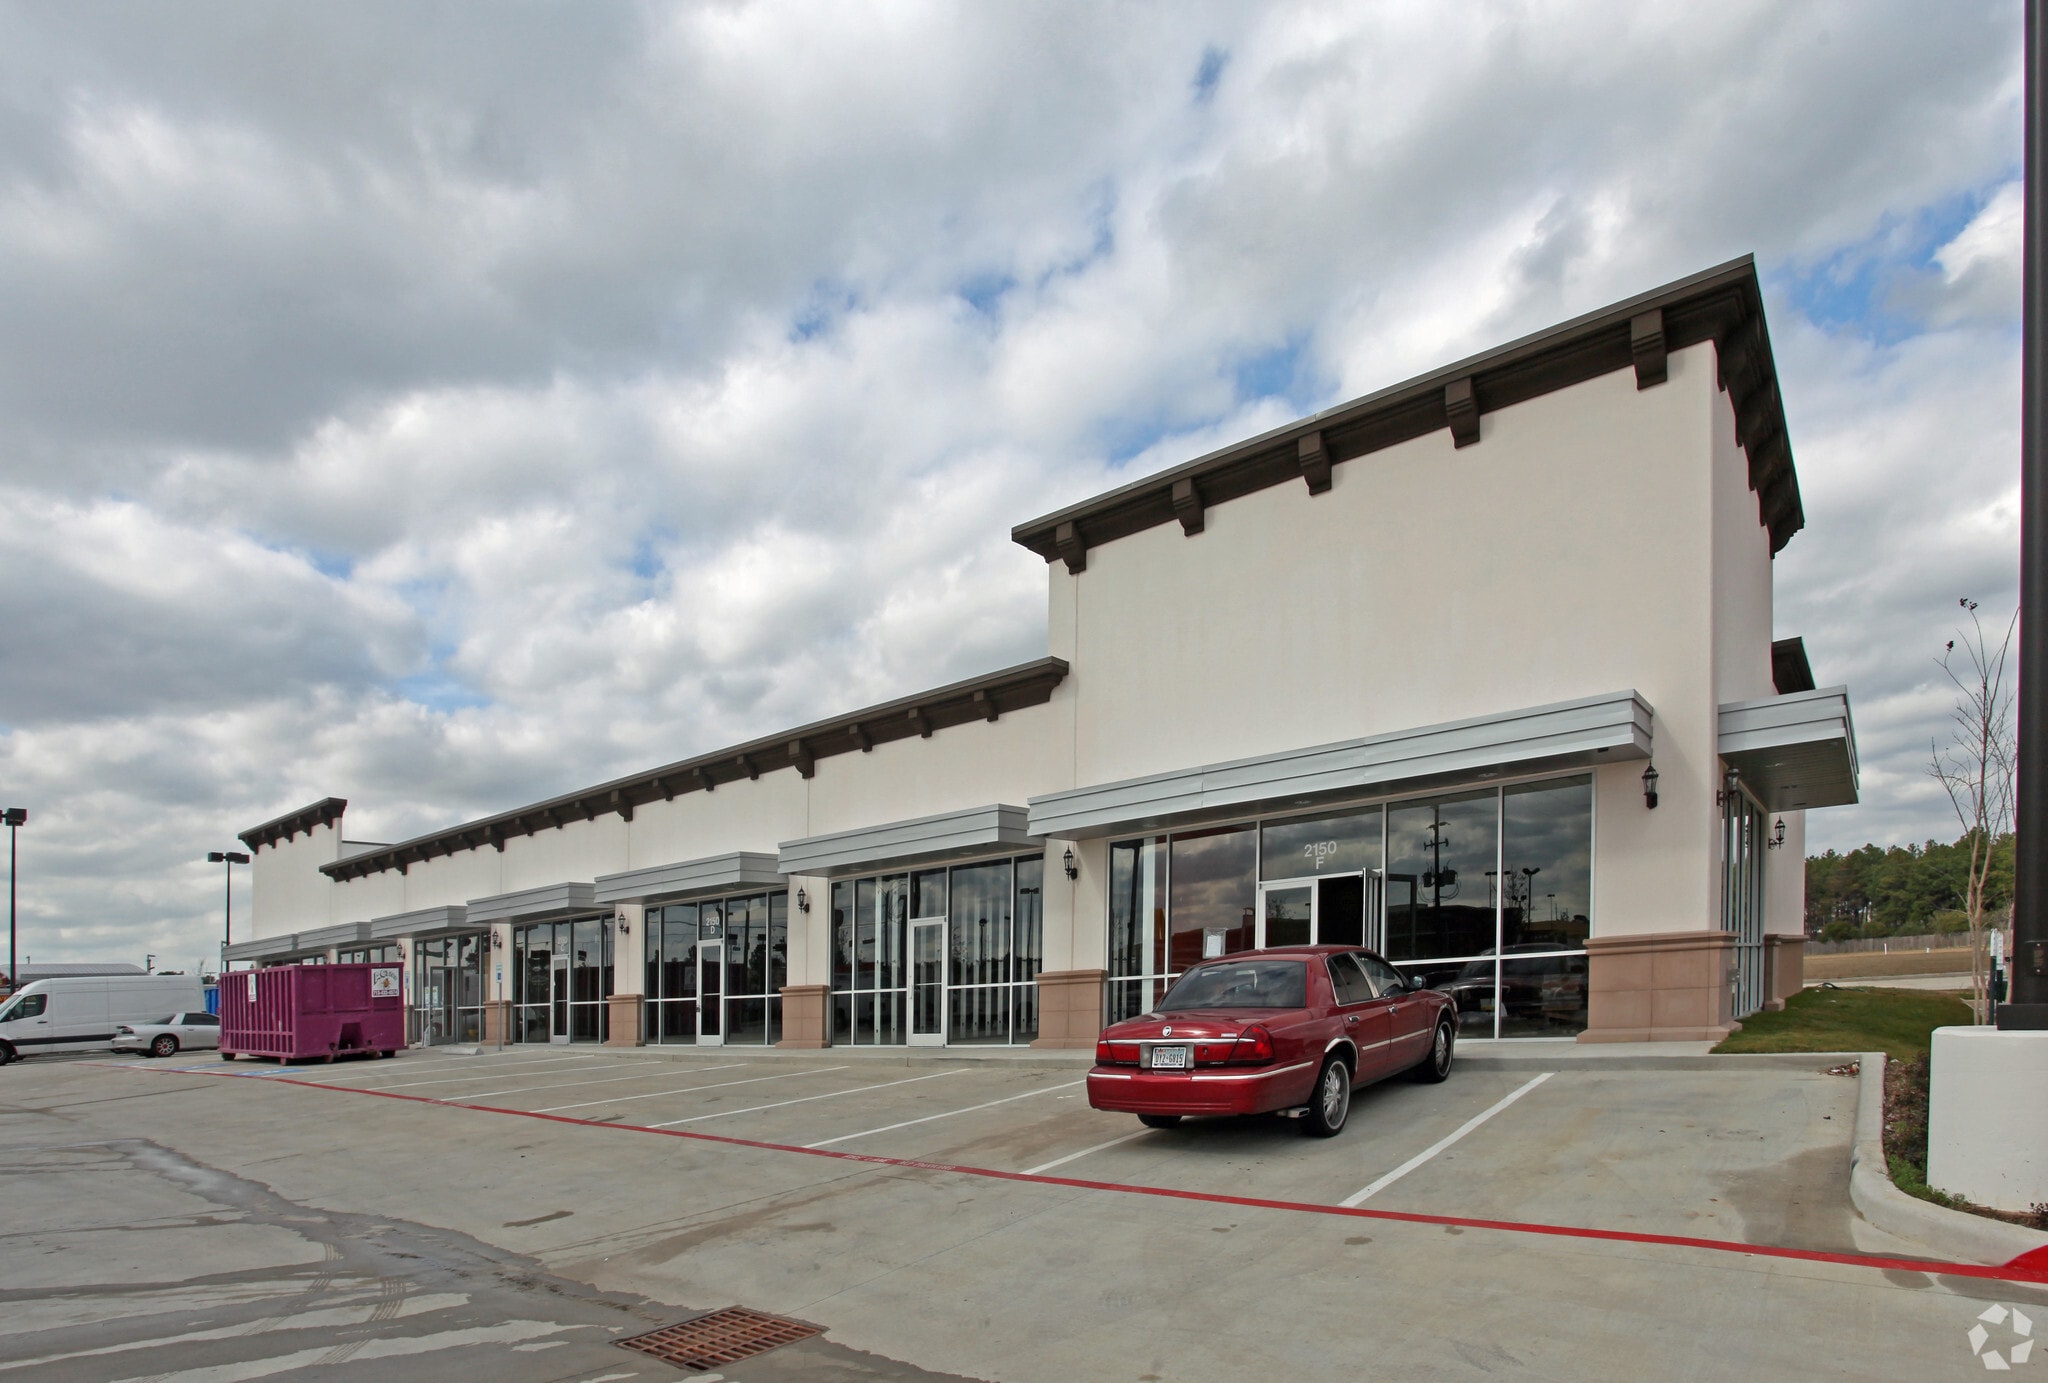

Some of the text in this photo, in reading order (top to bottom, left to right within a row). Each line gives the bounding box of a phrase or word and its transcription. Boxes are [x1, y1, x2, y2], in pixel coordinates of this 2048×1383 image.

[1304, 841, 1337, 857] 2150
[1316, 857, 1324, 869] F
[705, 916, 720, 926] 2150
[710, 926, 715, 934] D
